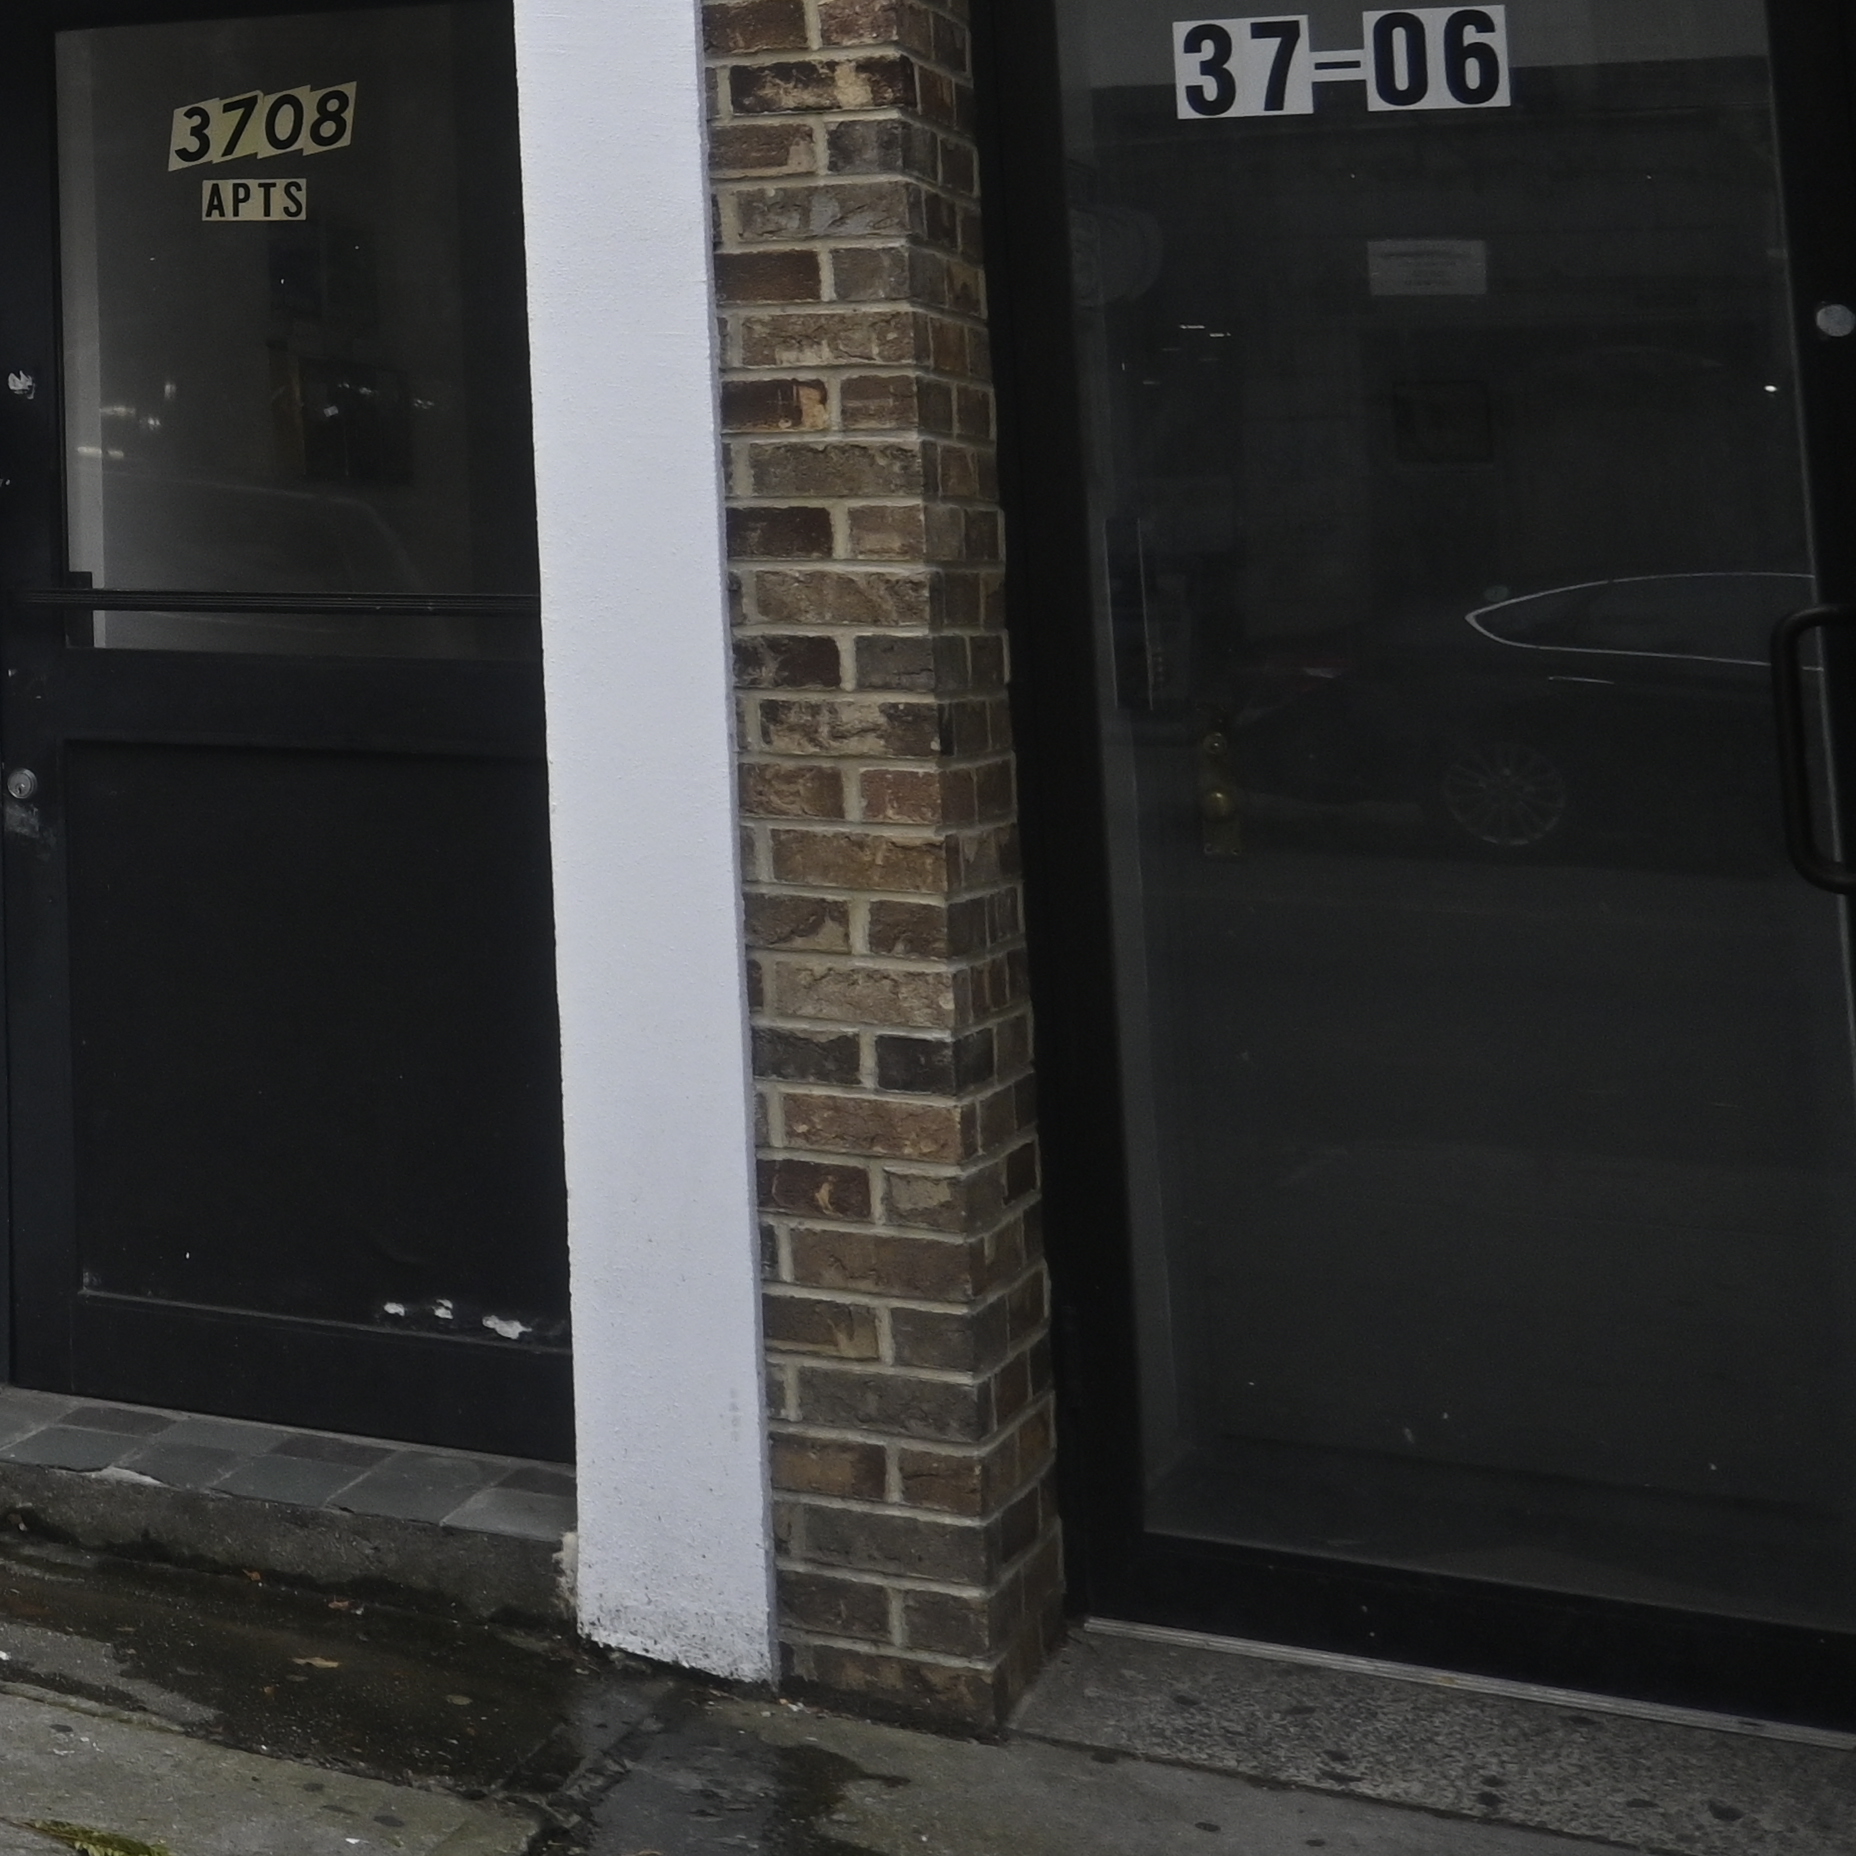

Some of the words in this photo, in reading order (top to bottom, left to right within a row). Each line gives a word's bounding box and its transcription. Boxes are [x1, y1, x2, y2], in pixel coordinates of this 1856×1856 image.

[1182, 8, 1501, 117] 37-06
[174, 89, 350, 163] 3708
[205, 180, 303, 218] APTS
